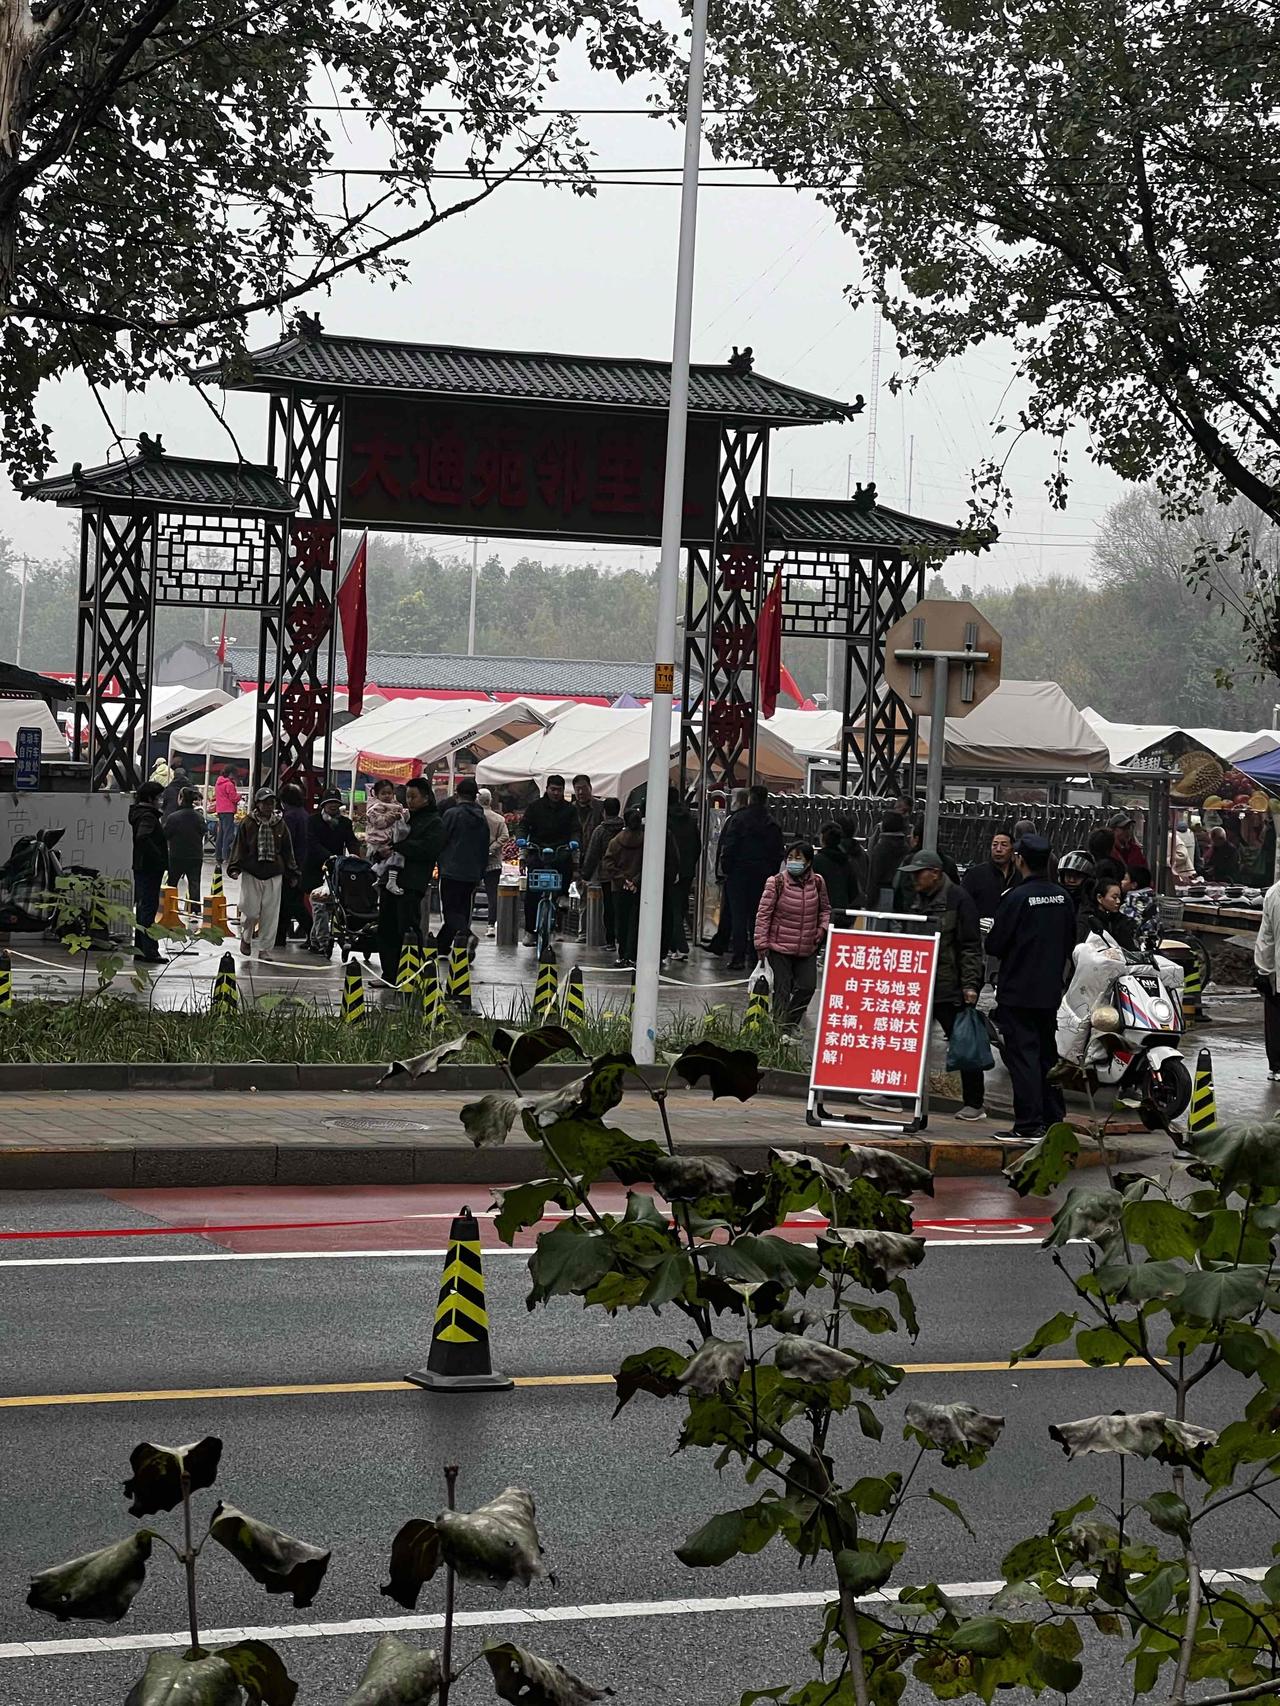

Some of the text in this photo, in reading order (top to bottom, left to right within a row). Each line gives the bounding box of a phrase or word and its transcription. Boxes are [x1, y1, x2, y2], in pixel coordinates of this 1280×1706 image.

[19, 746, 40, 758] 自行车
[835, 945, 930, 974] 天通苑邻里汇
[845, 977, 921, 997] 由于场地受
[829, 994, 923, 1015] 限，无法停放
[826, 1013, 920, 1034] 车辆，感谢大
[824, 1031, 918, 1053] 家的支持与理
[822, 1050, 844, 1066] 解！
[870, 1069, 908, 1086] 谢谢！
